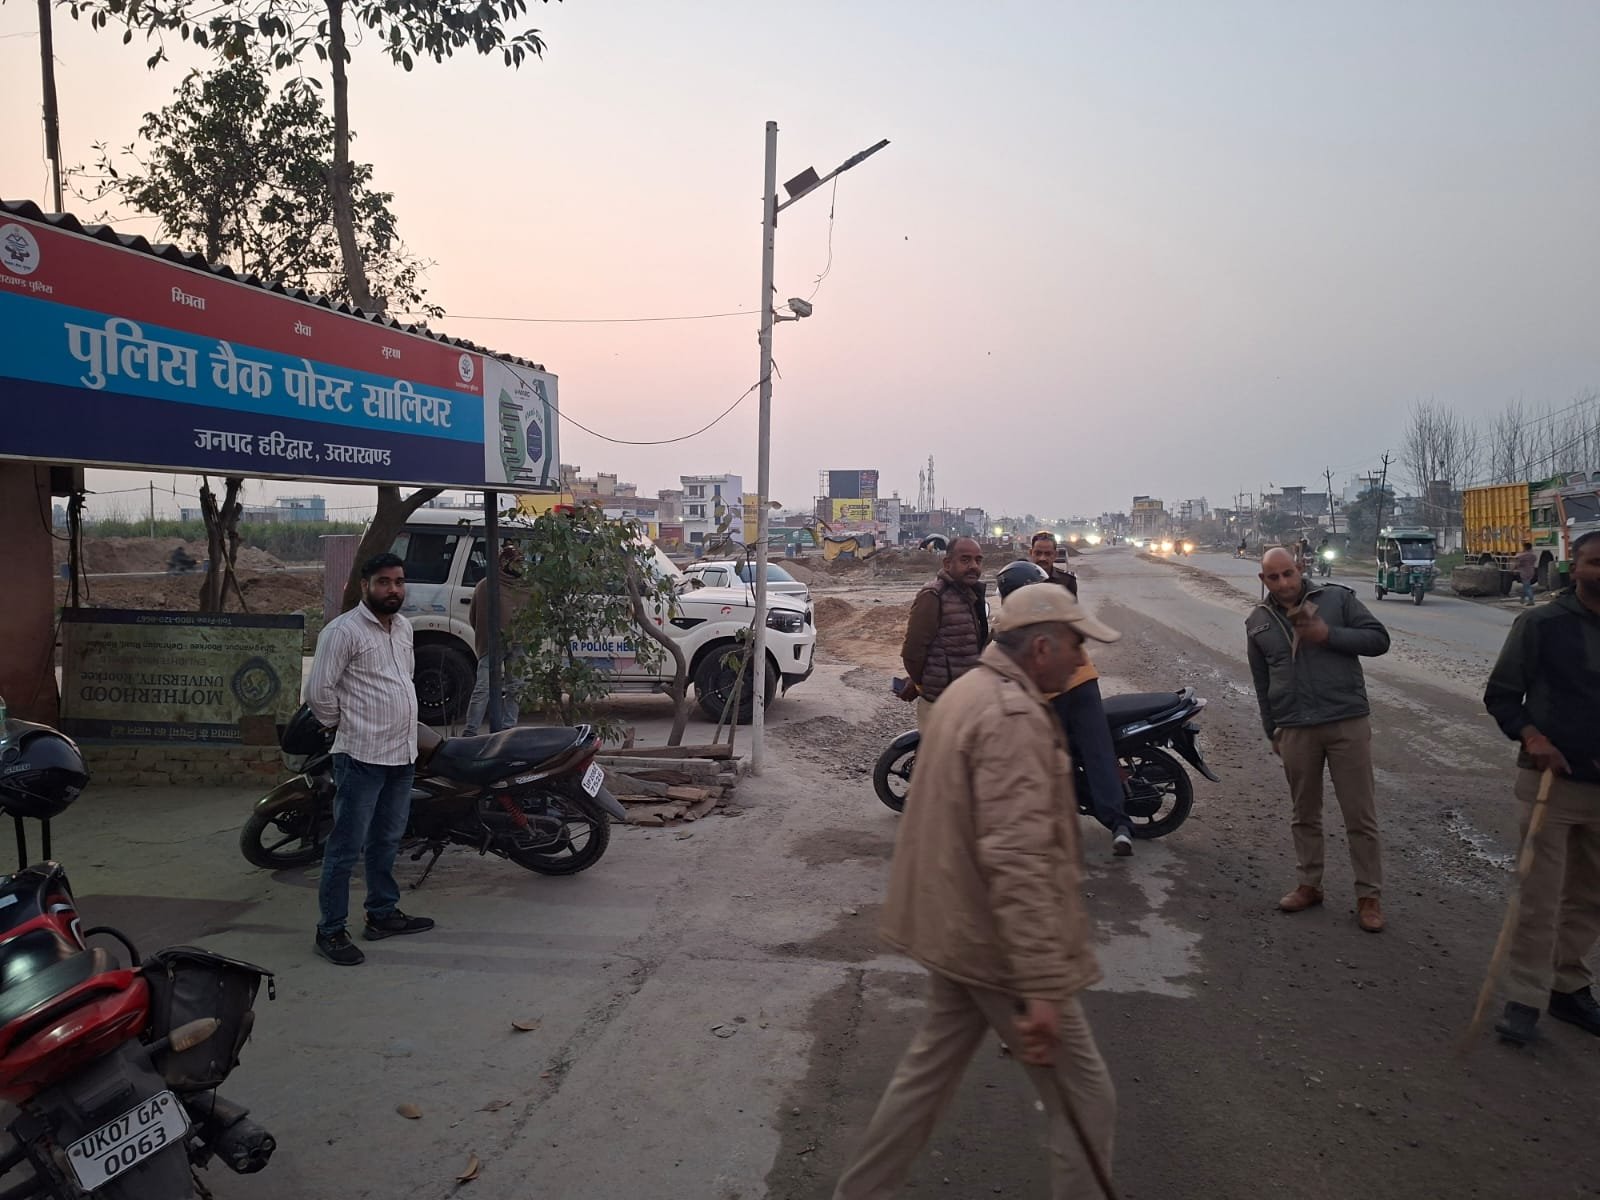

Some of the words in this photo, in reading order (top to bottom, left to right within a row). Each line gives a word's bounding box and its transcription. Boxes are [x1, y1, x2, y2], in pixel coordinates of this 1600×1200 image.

[171, 286, 206, 311] मित्रता
[294, 320, 312, 337] सेवा
[381, 345, 401, 360] सुरक्षा
[64, 317, 198, 390] पुलिस
[209, 340, 273, 399] चैक
[282, 358, 353, 413] पोस्ट
[361, 379, 452, 428] सालियर
[193, 428, 254, 456] जनपद
[323, 442, 392, 466] उत्तराखण्ड
[80, 685, 223, 706] MOTHERHOOD
[82, 1116, 130, 1159] UK07
[138, 1100, 163, 1126] GA
[104, 1127, 166, 1176] 0063
